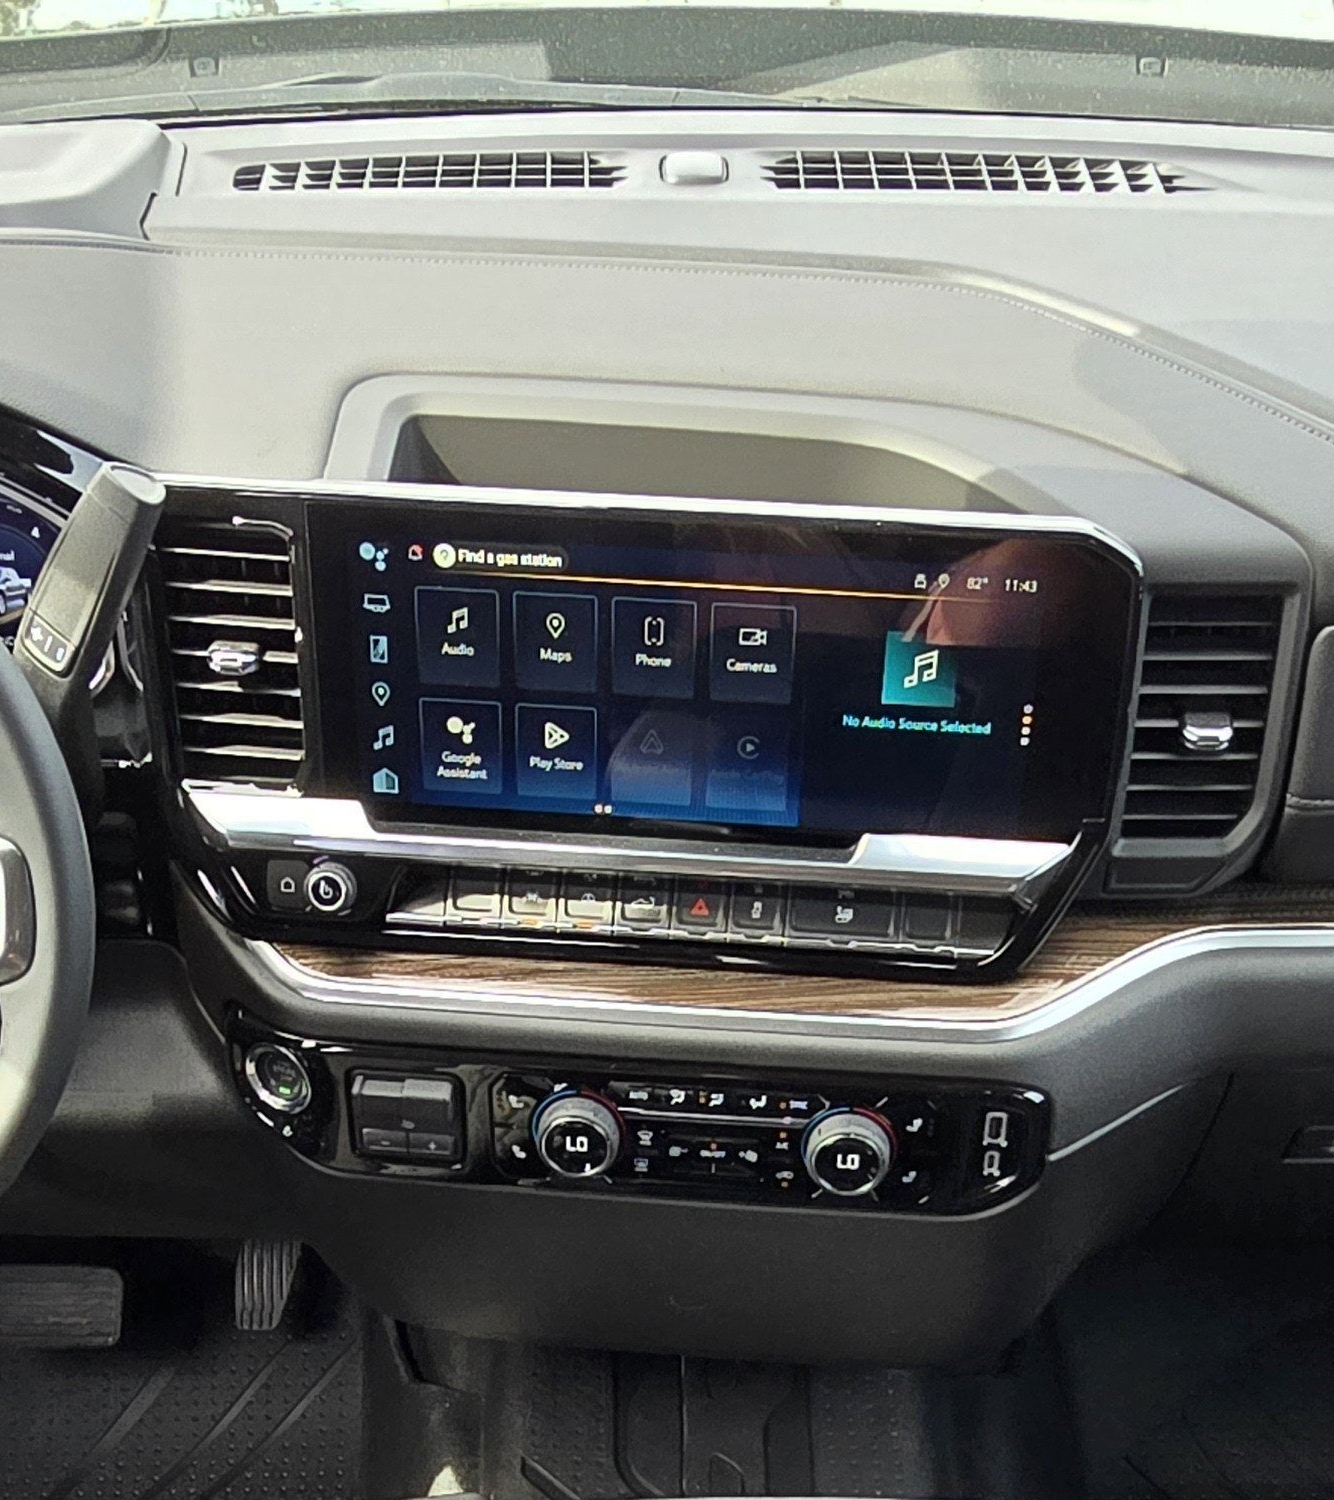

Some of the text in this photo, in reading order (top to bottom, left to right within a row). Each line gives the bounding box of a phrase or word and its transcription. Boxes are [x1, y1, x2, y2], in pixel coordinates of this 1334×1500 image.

[31, 526, 41, 539] 4
[458, 548, 563, 568] Find a gas station
[1004, 578, 1038, 593] 11:43
[441, 642, 475, 656] Audio
[539, 648, 572, 664] Maps
[635, 653, 672, 668] Phone
[726, 658, 778, 673] Cameras
[842, 714, 992, 735] No Audio Source Selected
[441, 751, 482, 767] Google
[529, 755, 584, 772] Play Store
[436, 765, 488, 780] Assistant
[566, 1135, 589, 1152] LO
[836, 1153, 861, 1171] LO
